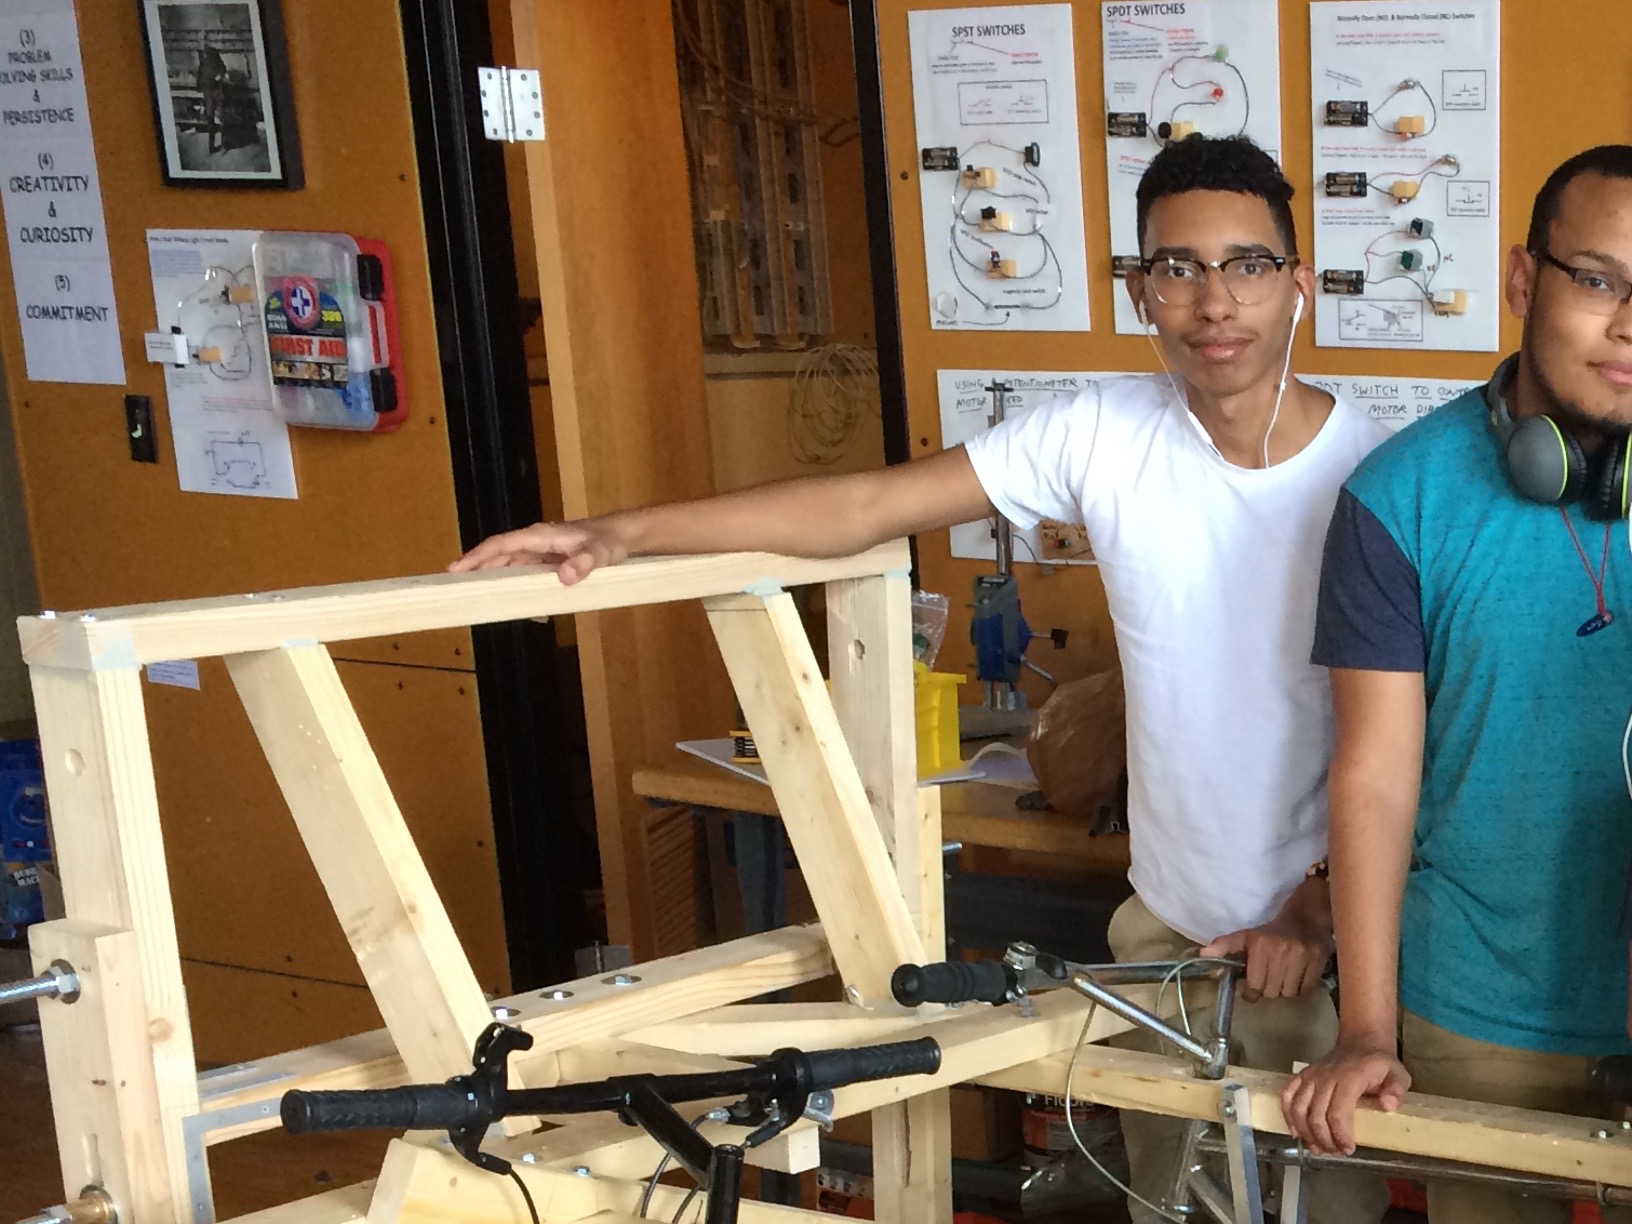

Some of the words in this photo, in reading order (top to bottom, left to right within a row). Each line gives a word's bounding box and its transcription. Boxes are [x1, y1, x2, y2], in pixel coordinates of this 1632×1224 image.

[1134, 3, 1186, 16] SWITCHES
[952, 26, 974, 38] SPST
[977, 23, 1026, 37] SWITCHES
[8, 50, 52, 64] PROBLEM
[39, 67, 74, 82] SKILLS
[3, 107, 75, 127] PERSISTENCE
[38, 152, 54, 171] (4)
[9, 176, 90, 193] CREATIVITY
[48, 201, 57, 217] &
[20, 227, 94, 243] CURIOSITY
[55, 274, 71, 292] (5)
[26, 305, 108, 322] COMMITMENT
[270, 335, 313, 356] FIRST
[318, 338, 347, 357] AID
[1352, 385, 1399, 396] SWITCH
[1412, 386, 1430, 396] TO
[1367, 404, 1408, 415] MOTOR
